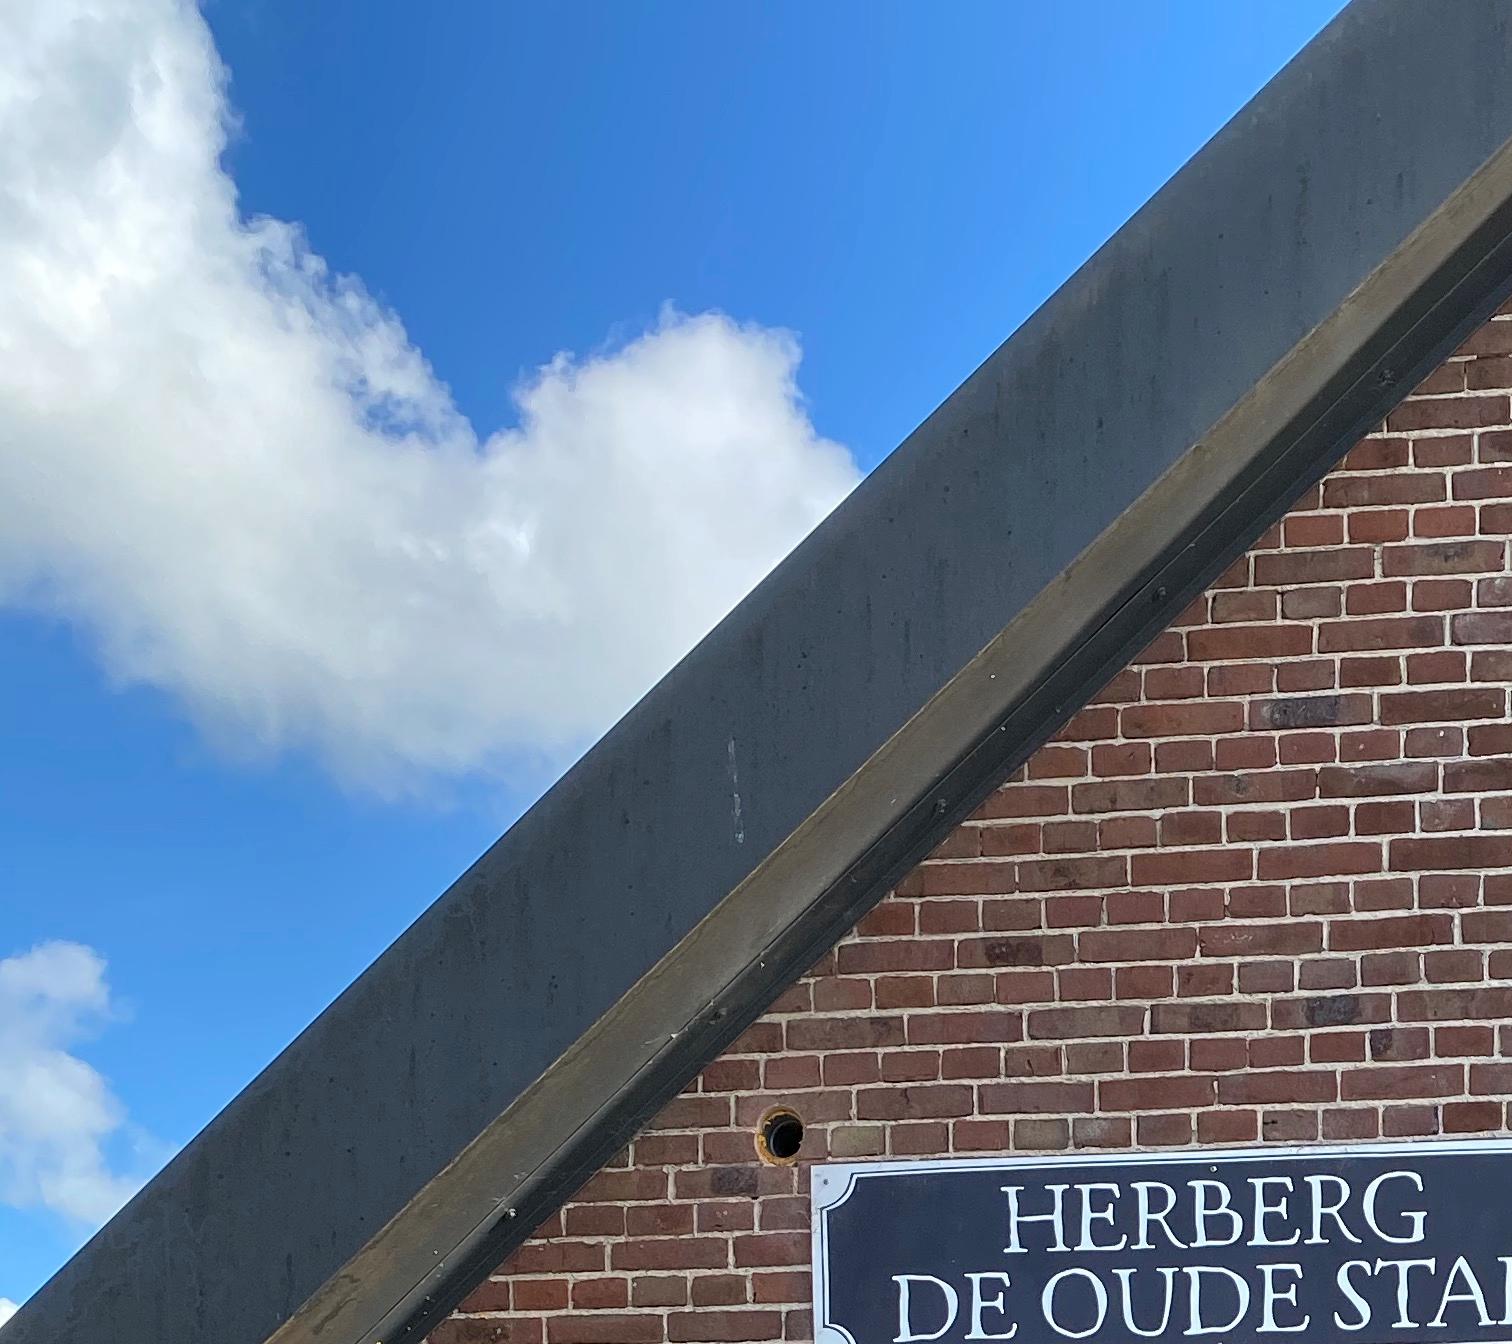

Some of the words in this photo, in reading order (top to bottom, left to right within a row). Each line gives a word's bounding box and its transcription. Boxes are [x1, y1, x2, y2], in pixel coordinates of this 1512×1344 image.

[1000, 1170, 1428, 1254] HERBERG
[891, 1271, 1018, 1343] DE
[1041, 1260, 1310, 1339] OUDE
